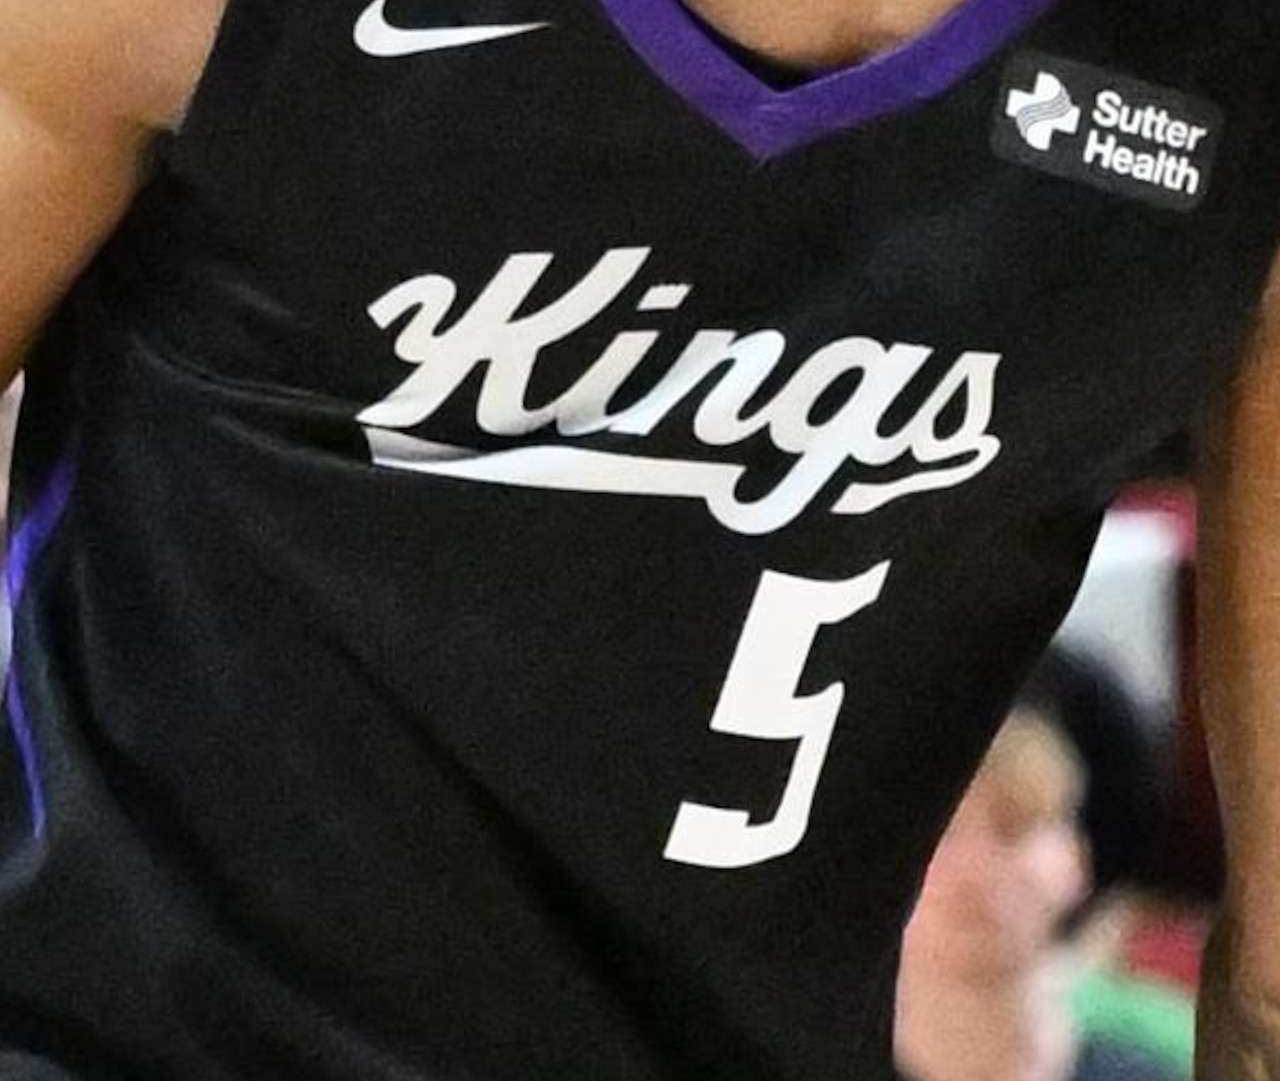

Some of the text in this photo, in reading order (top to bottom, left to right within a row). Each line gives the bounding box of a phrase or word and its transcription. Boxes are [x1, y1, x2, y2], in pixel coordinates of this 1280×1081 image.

[1082, 128, 1200, 195] Health
[1091, 89, 1207, 151] Sutter
[356, 247, 1001, 534] Kings
[664, 560, 890, 868] 5
